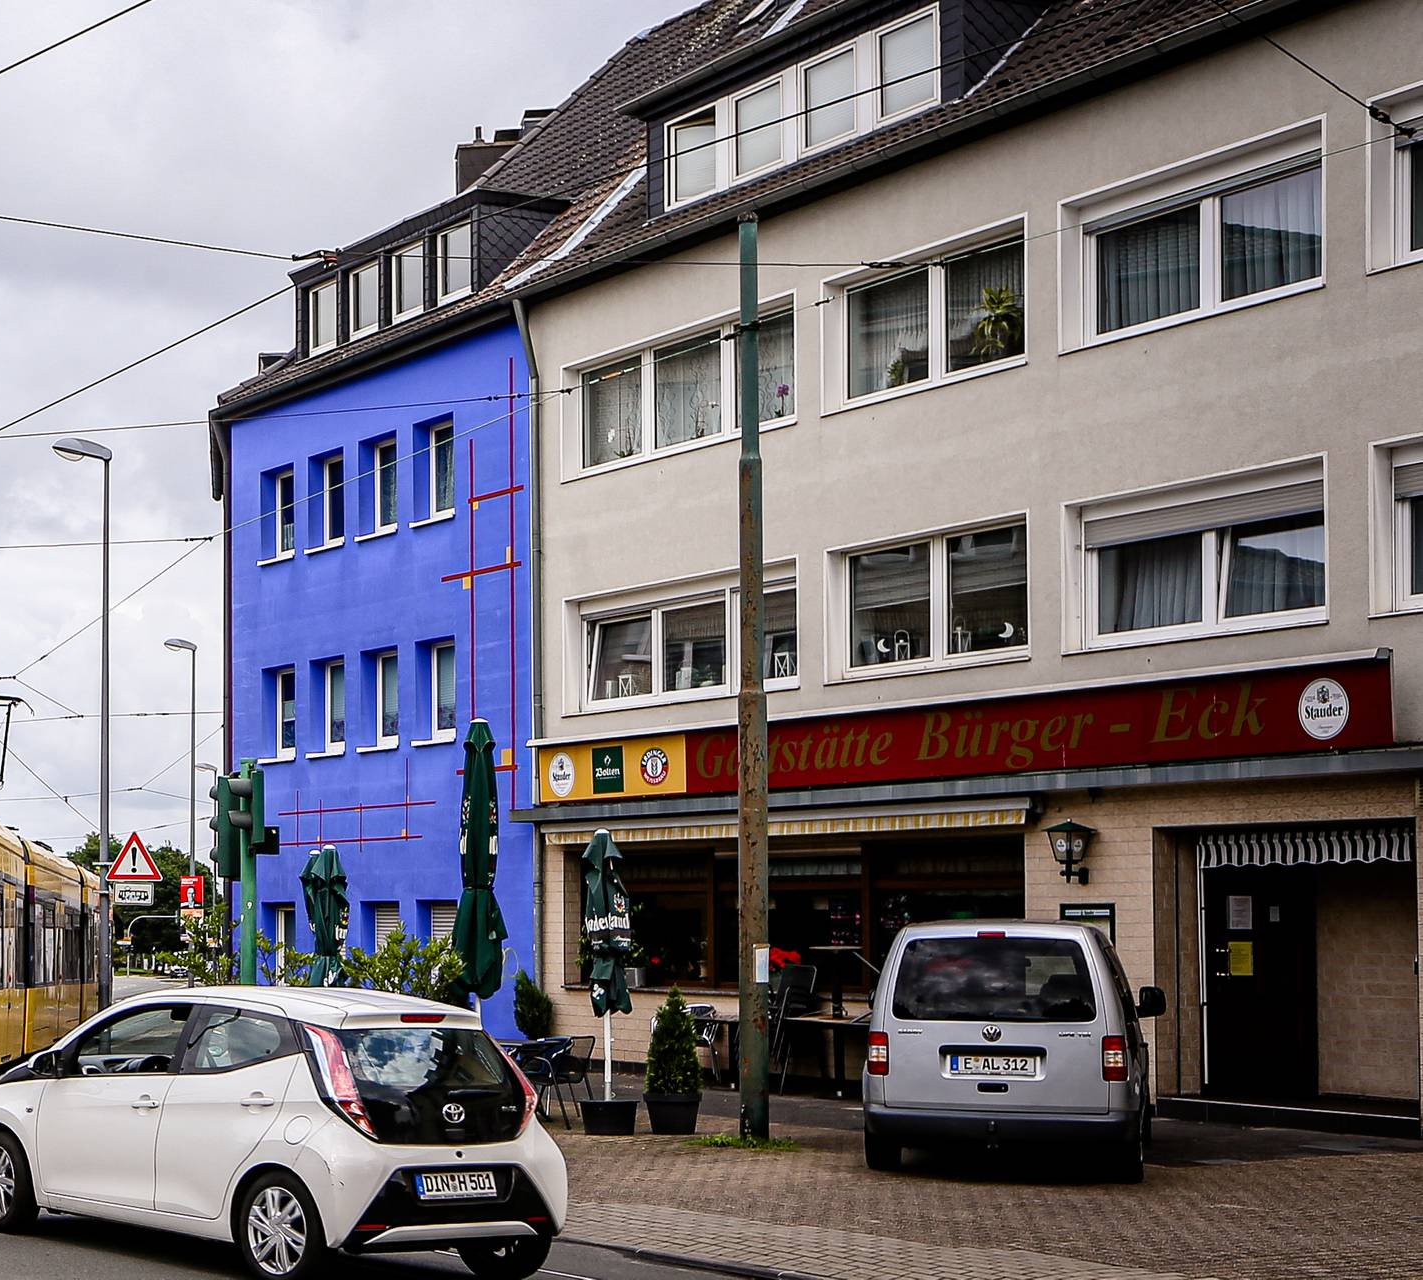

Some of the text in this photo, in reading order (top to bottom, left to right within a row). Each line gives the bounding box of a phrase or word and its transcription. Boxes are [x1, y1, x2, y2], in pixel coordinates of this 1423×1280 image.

[1304, 703, 1344, 721] Stauder
[915, 709, 1094, 769] Bürger
[1148, 681, 1268, 744] Eck
[964, 1057, 1029, 1071] E AL 312
[424, 1173, 494, 1192] DIN H 501
